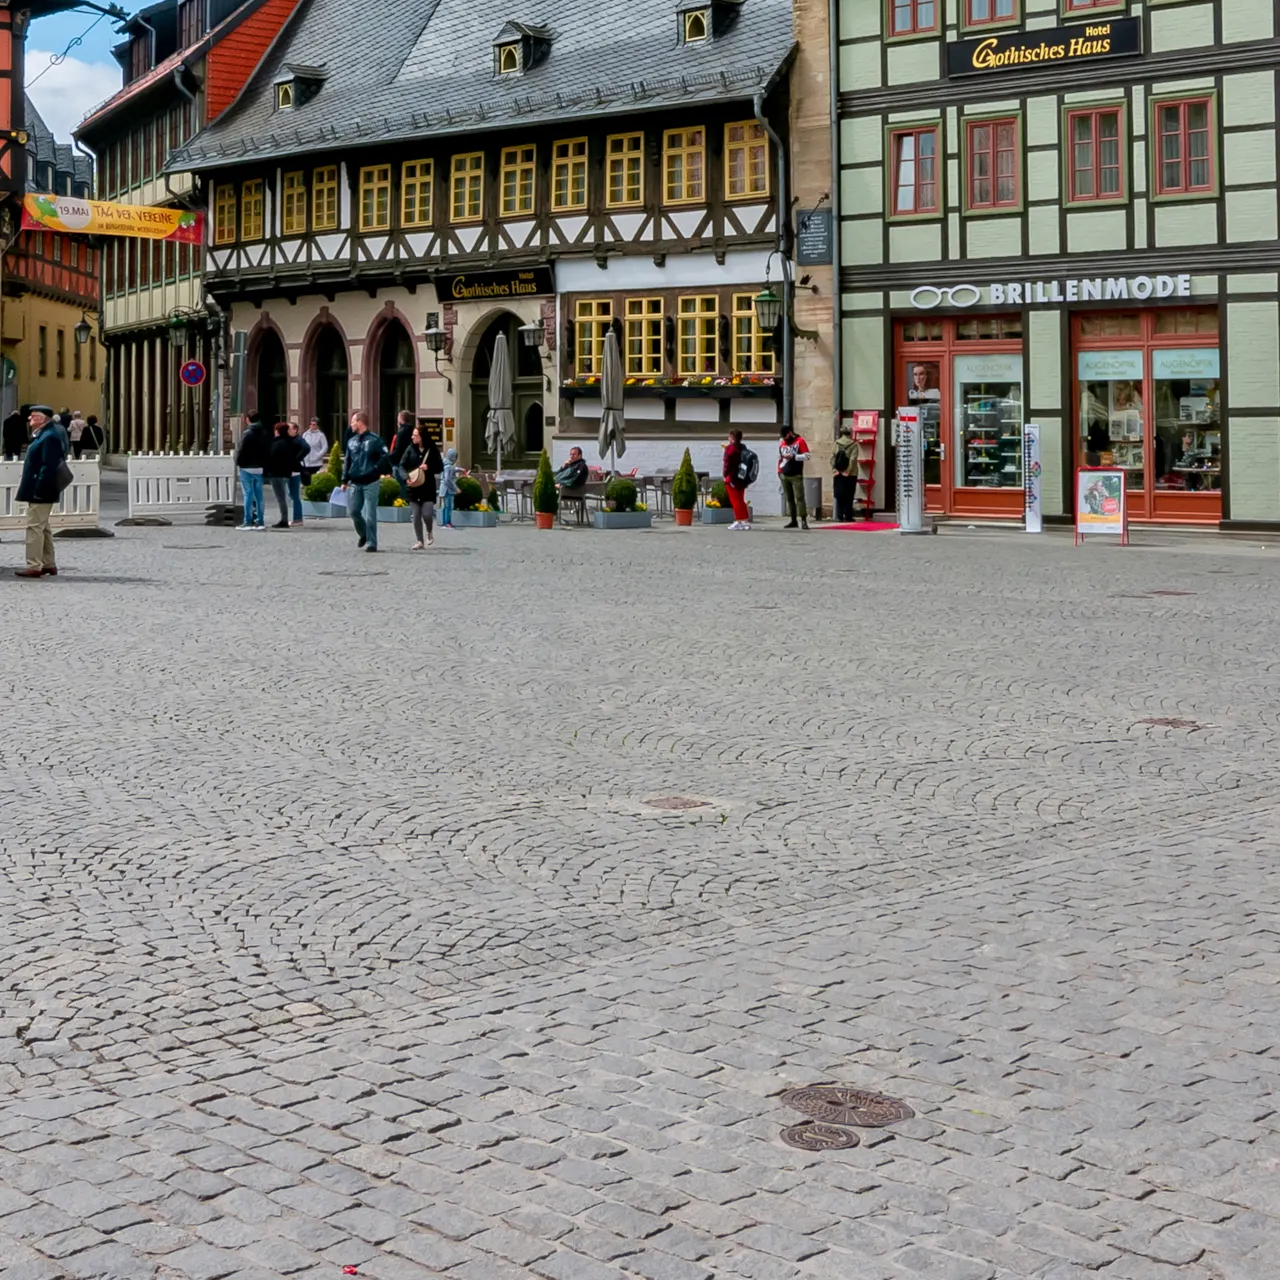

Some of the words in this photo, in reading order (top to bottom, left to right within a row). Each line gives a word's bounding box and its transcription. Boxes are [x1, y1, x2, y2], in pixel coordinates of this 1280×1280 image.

[1085, 24, 1111, 37] Hotel
[972, 38, 1065, 68] Gothisches
[1068, 37, 1111, 57] Haus
[93, 205, 114, 219] TAG
[116, 209, 134, 221] DER
[135, 210, 175, 225] VEREINE
[452, 276, 510, 298] Gothisches
[511, 280, 537, 294] Haus
[990, 274, 1191, 304] BRILLENMODE
